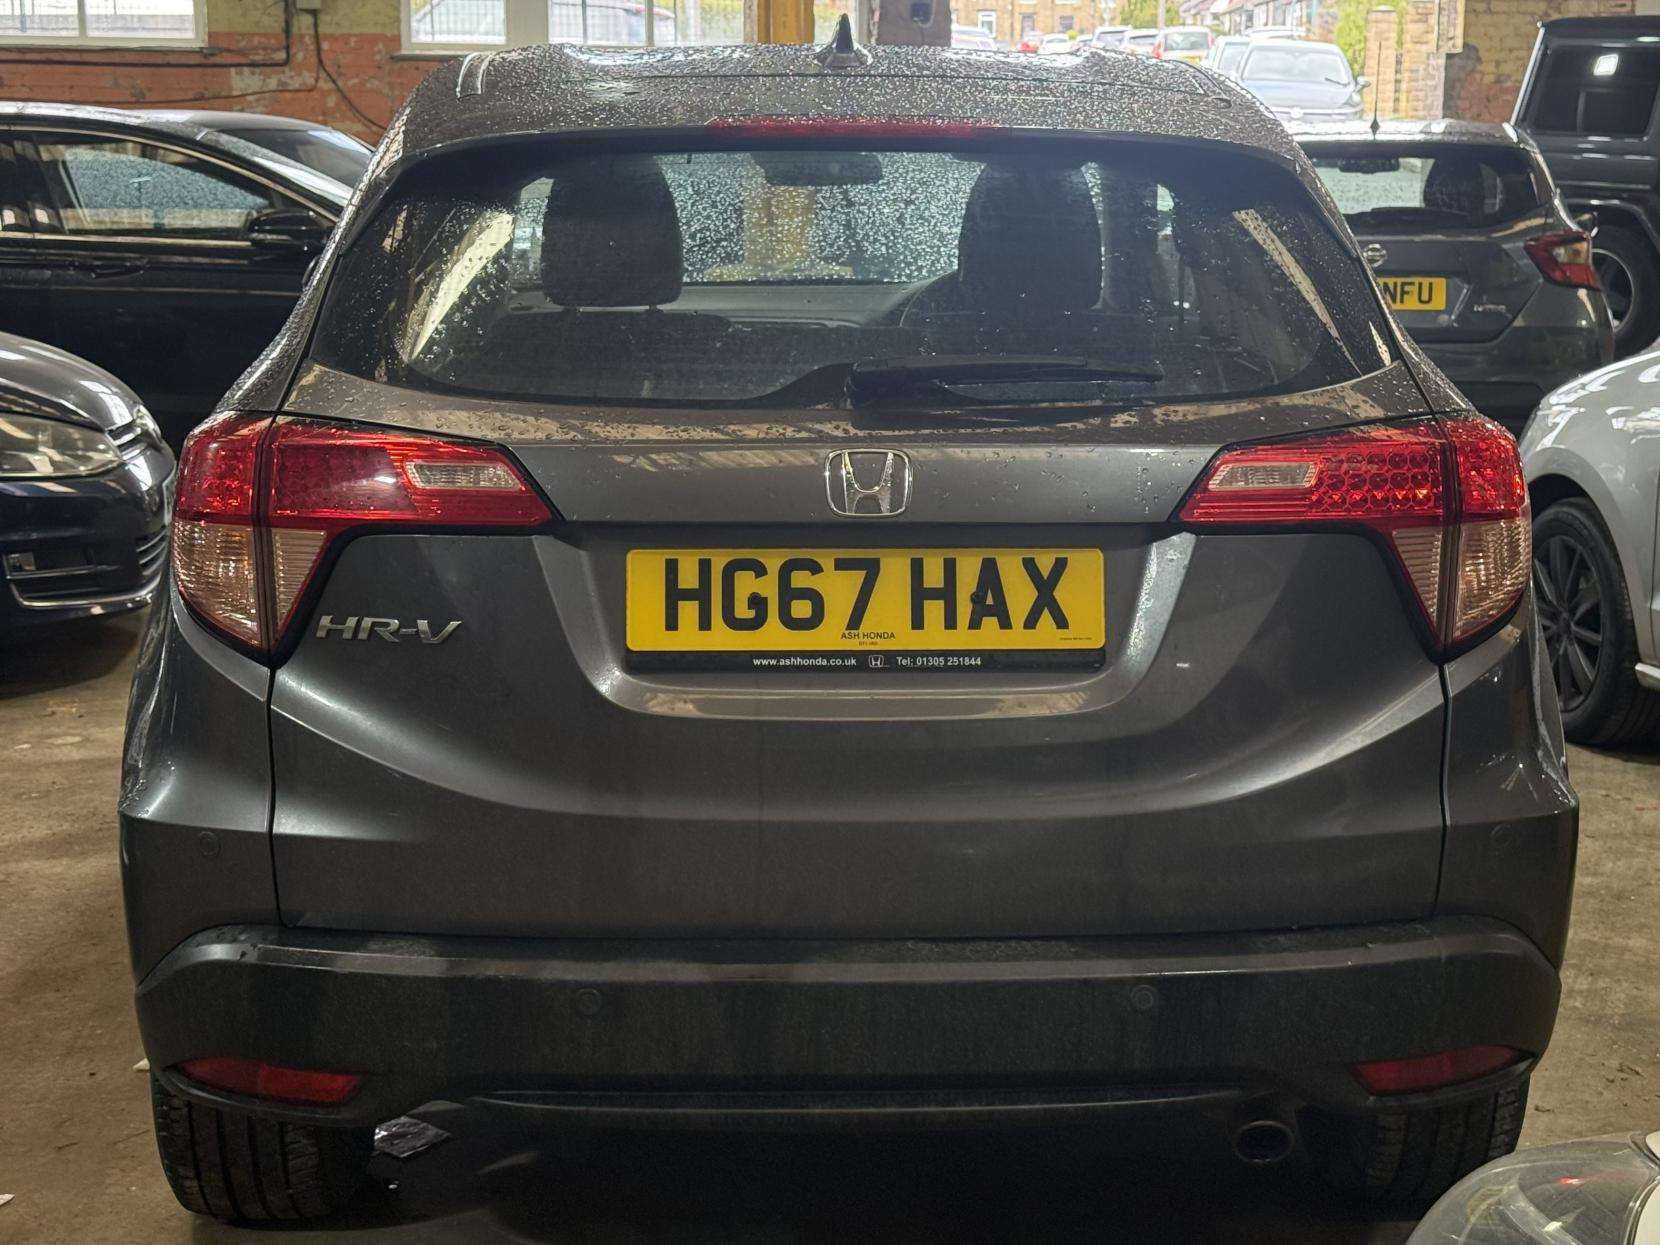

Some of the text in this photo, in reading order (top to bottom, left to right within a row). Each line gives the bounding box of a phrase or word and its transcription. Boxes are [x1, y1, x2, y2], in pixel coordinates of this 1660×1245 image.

[664, 557, 1069, 631] HG67 HAX
[316, 615, 463, 644] HR-V
[841, 632, 896, 640] ASH HONDA
[752, 656, 857, 666] www.ashhonda.co.uk
[896, 656, 914, 666] Tel:
[916, 656, 945, 666] 01305
[947, 656, 982, 666] 251844
